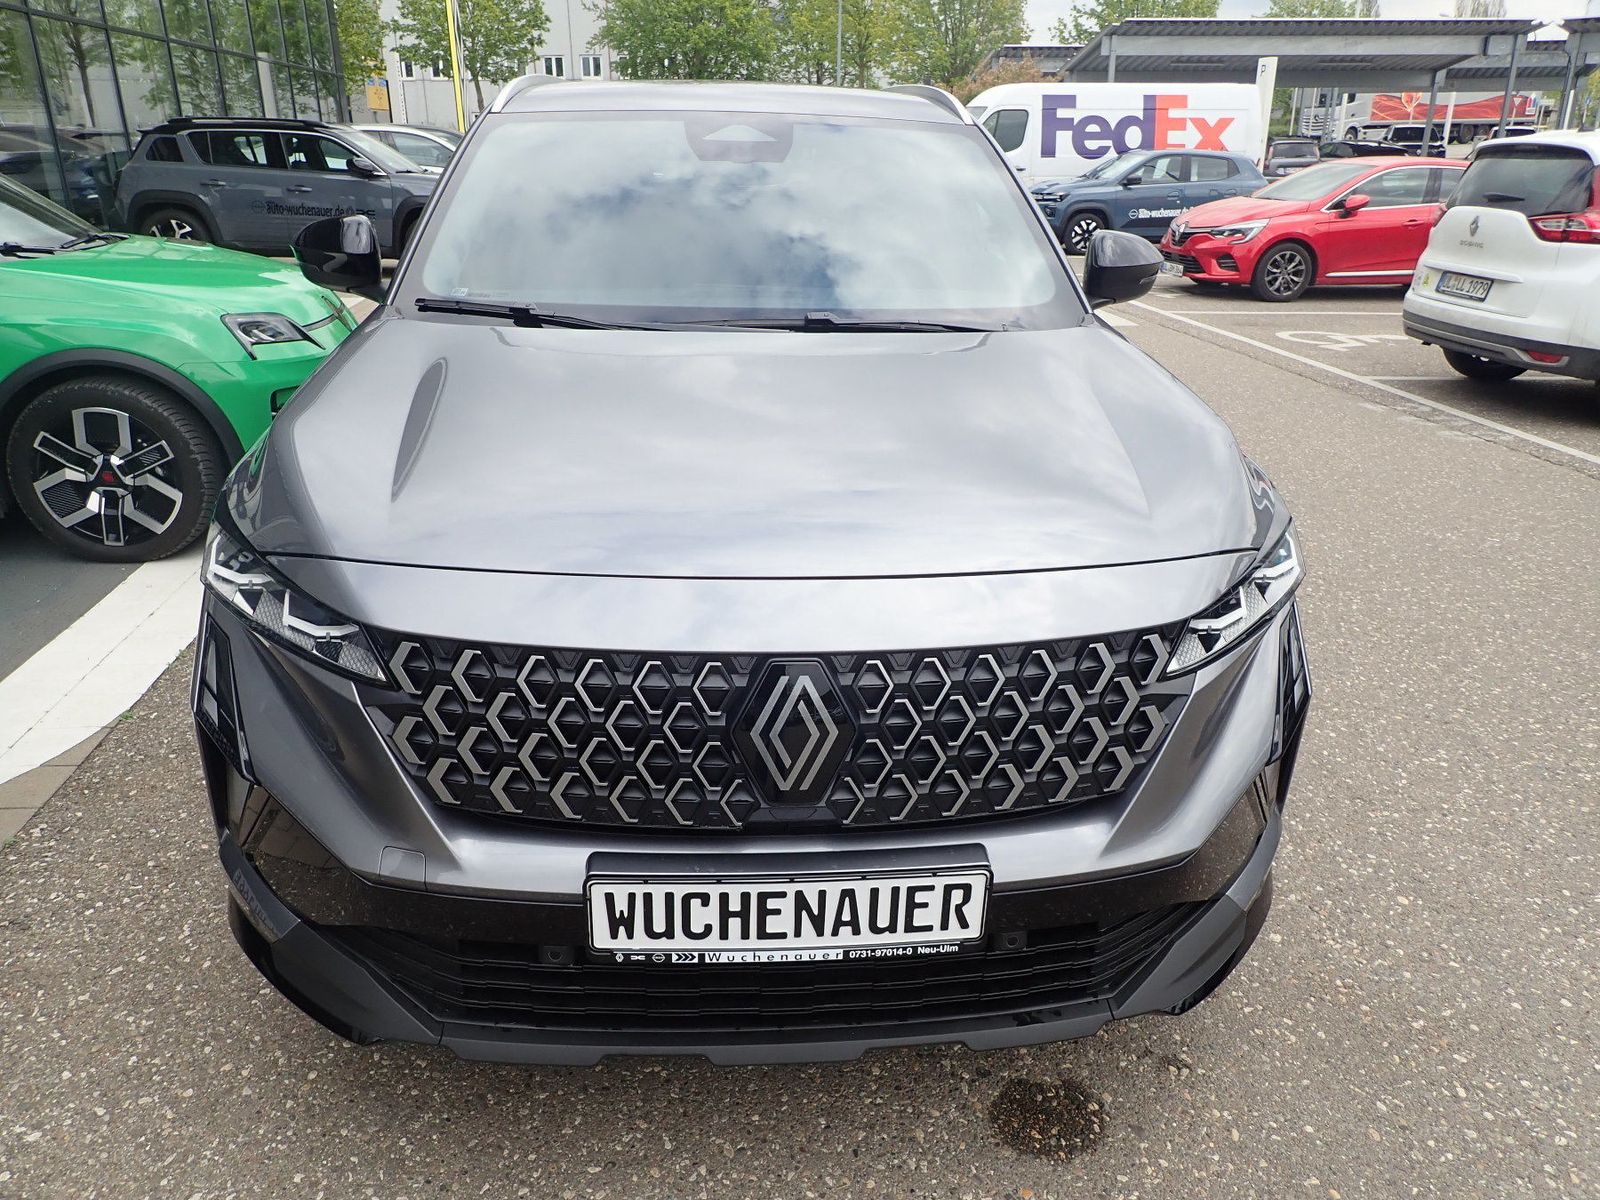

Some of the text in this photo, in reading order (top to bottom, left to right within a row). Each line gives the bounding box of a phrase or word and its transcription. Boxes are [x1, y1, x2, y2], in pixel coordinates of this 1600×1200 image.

[1041, 95, 1235, 159] FedEx
[1466, 280, 1489, 296] 1979
[604, 883, 973, 940] WUCHENAUER
[707, 944, 959, 963] Wuchenauer 0731-97014-0 Neu-Ulm
